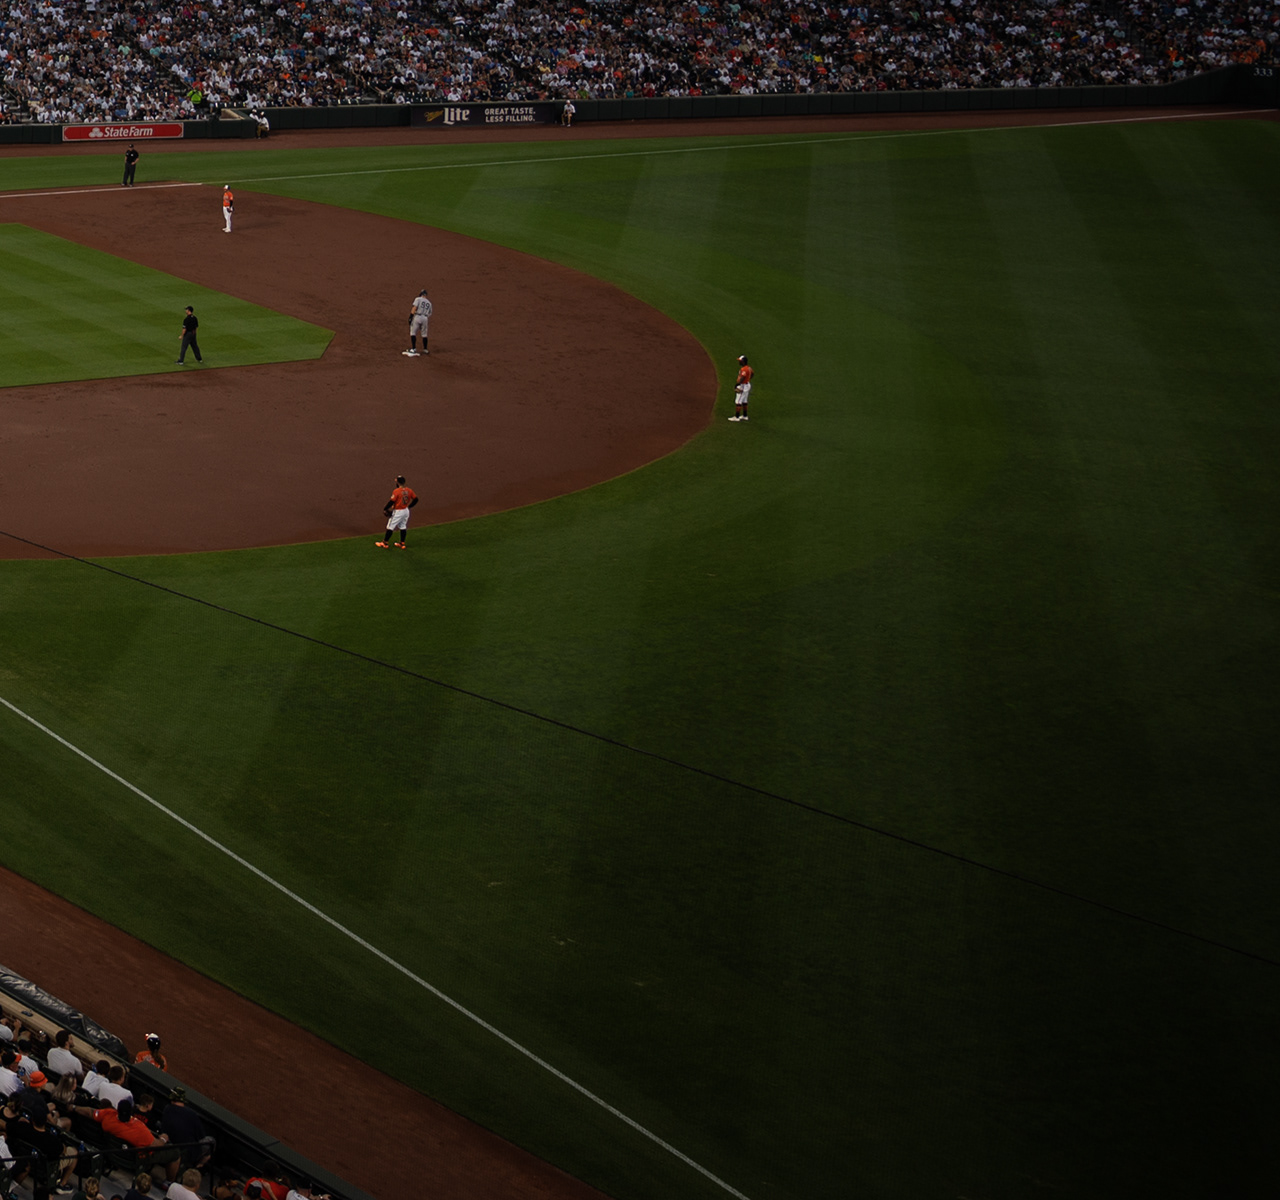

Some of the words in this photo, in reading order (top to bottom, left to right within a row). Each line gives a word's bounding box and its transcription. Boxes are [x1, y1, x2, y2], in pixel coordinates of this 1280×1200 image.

[484, 107, 510, 115] GREAT
[510, 107, 536, 115] TASTE.
[442, 107, 470, 125] Lite
[485, 115, 504, 123] LESS
[505, 114, 536, 122] FILLING.
